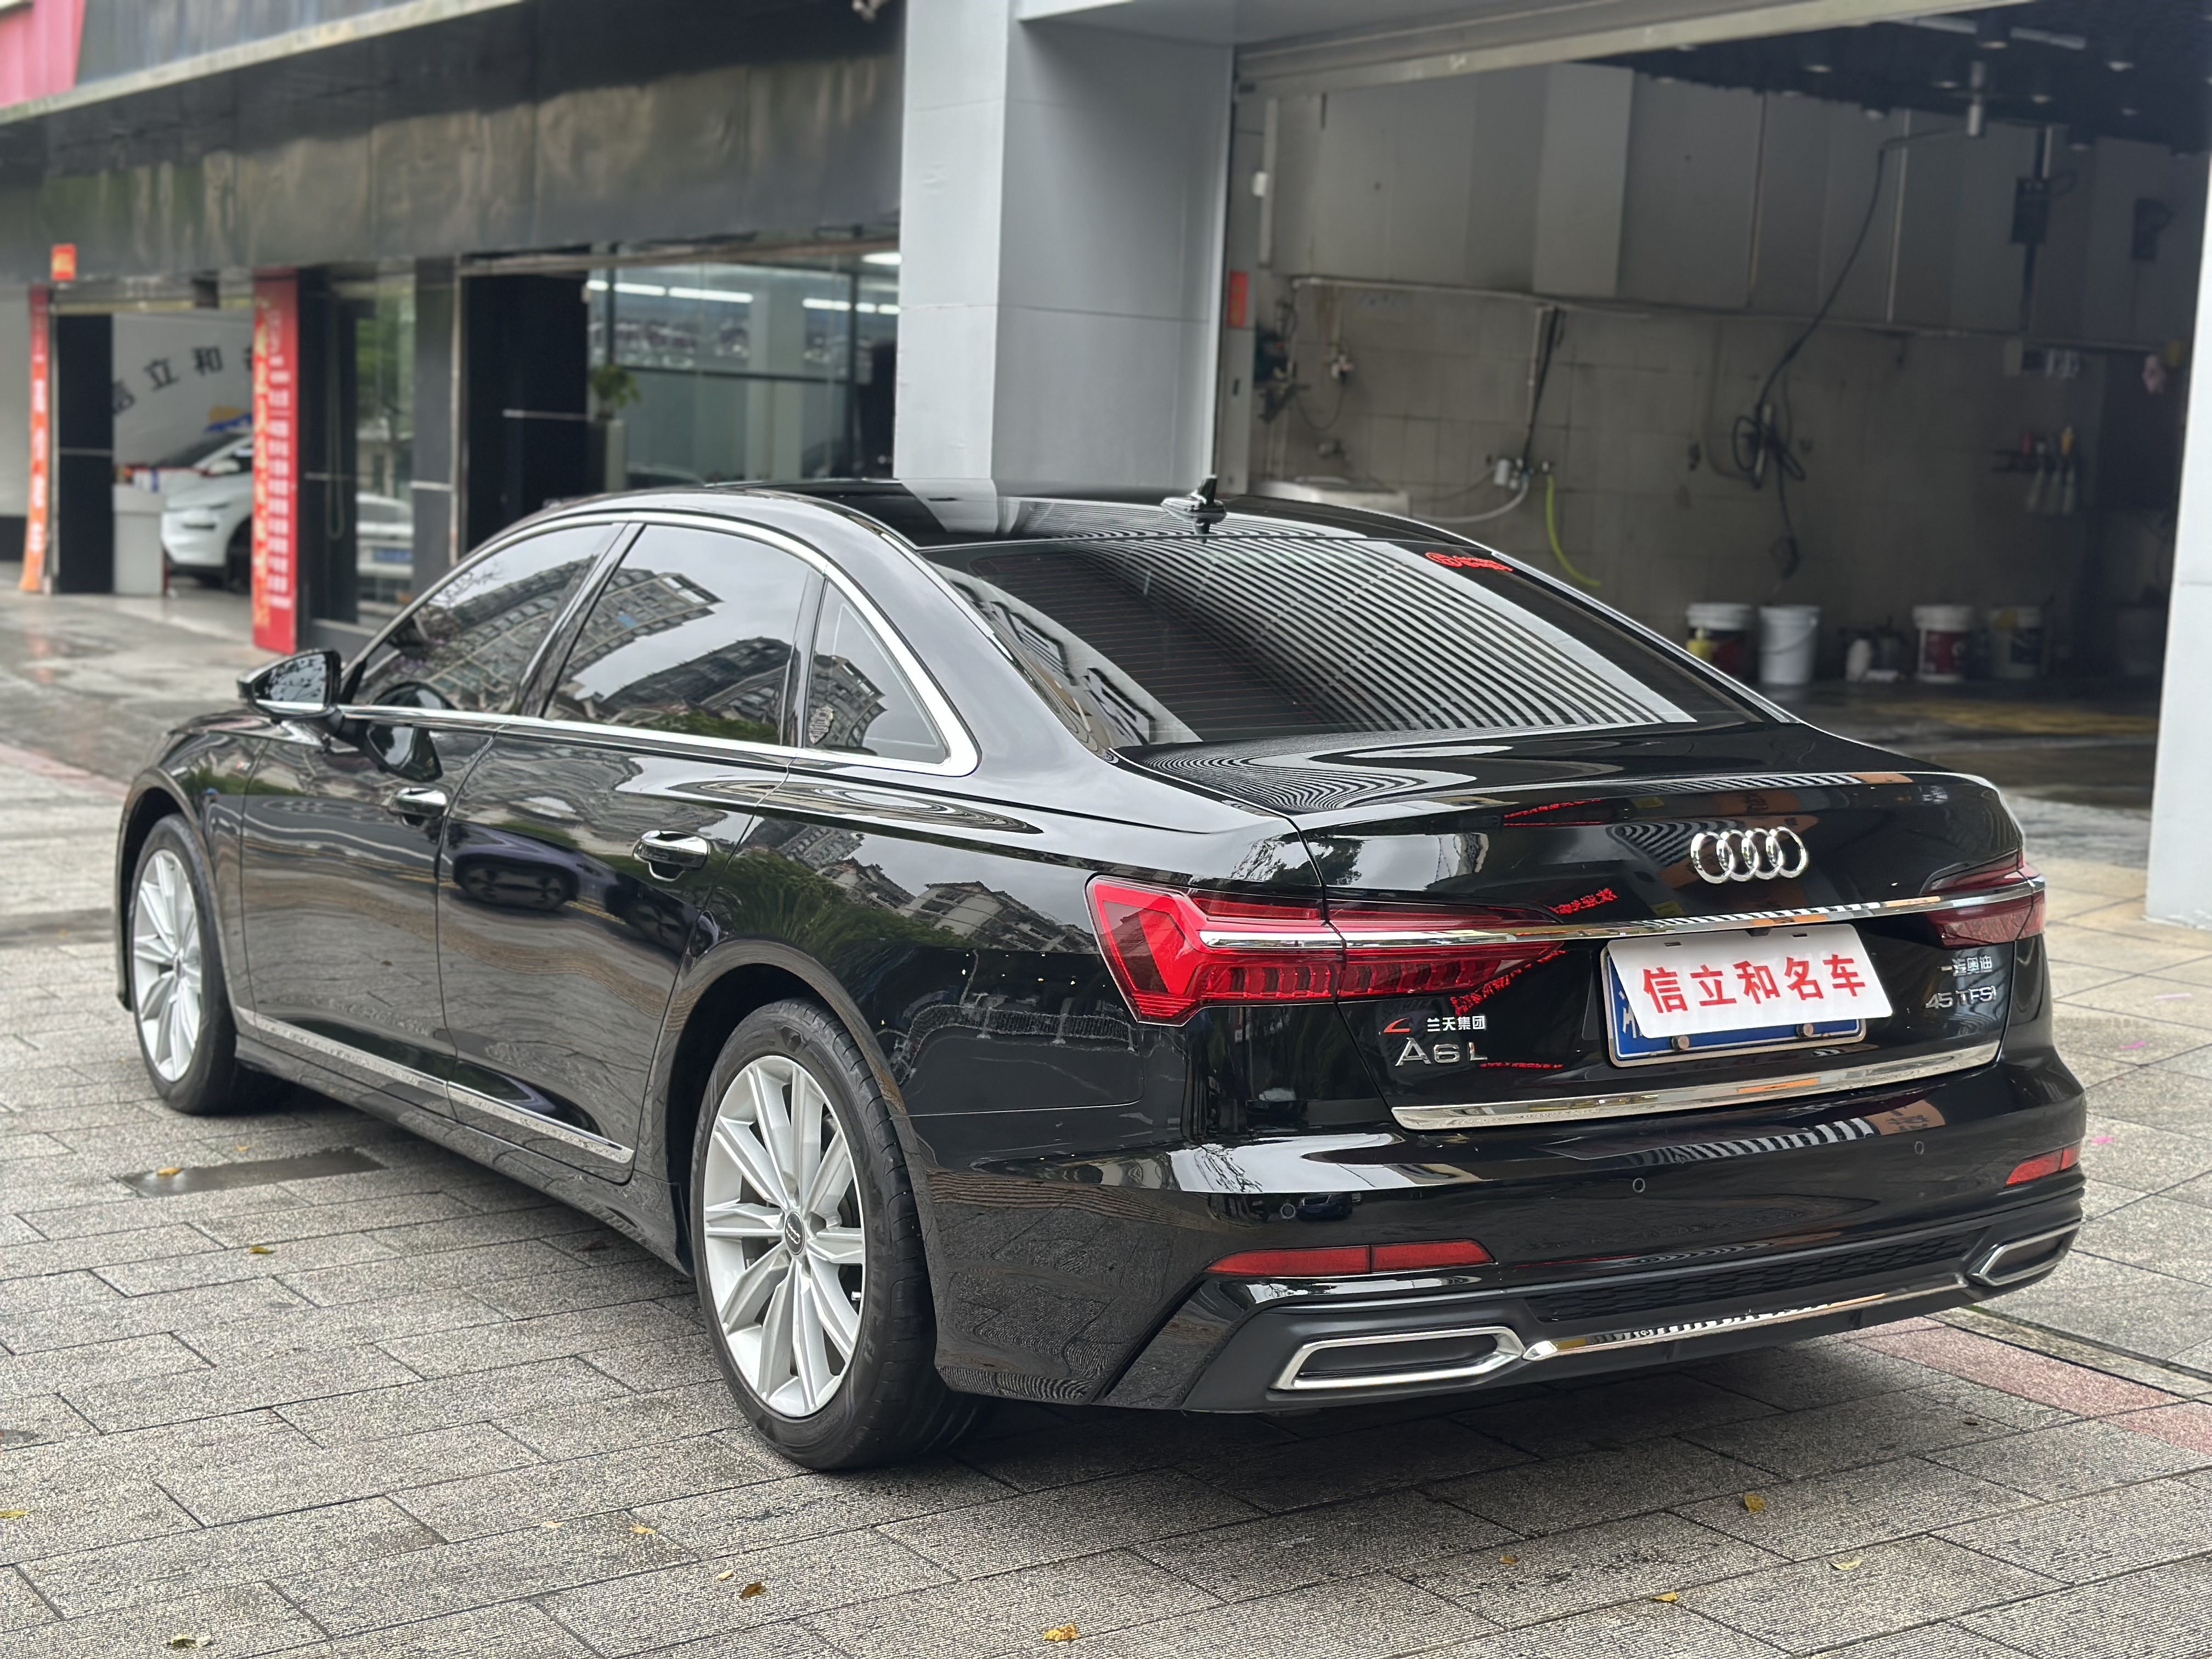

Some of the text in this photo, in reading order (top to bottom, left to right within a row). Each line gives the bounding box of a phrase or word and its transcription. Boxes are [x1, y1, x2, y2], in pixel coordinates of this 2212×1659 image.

[1642, 953, 1866, 1014] 信立和名车
[1925, 985, 1996, 1009] 45 TFSI
[1427, 1015, 1486, 1032] 兰天集团
